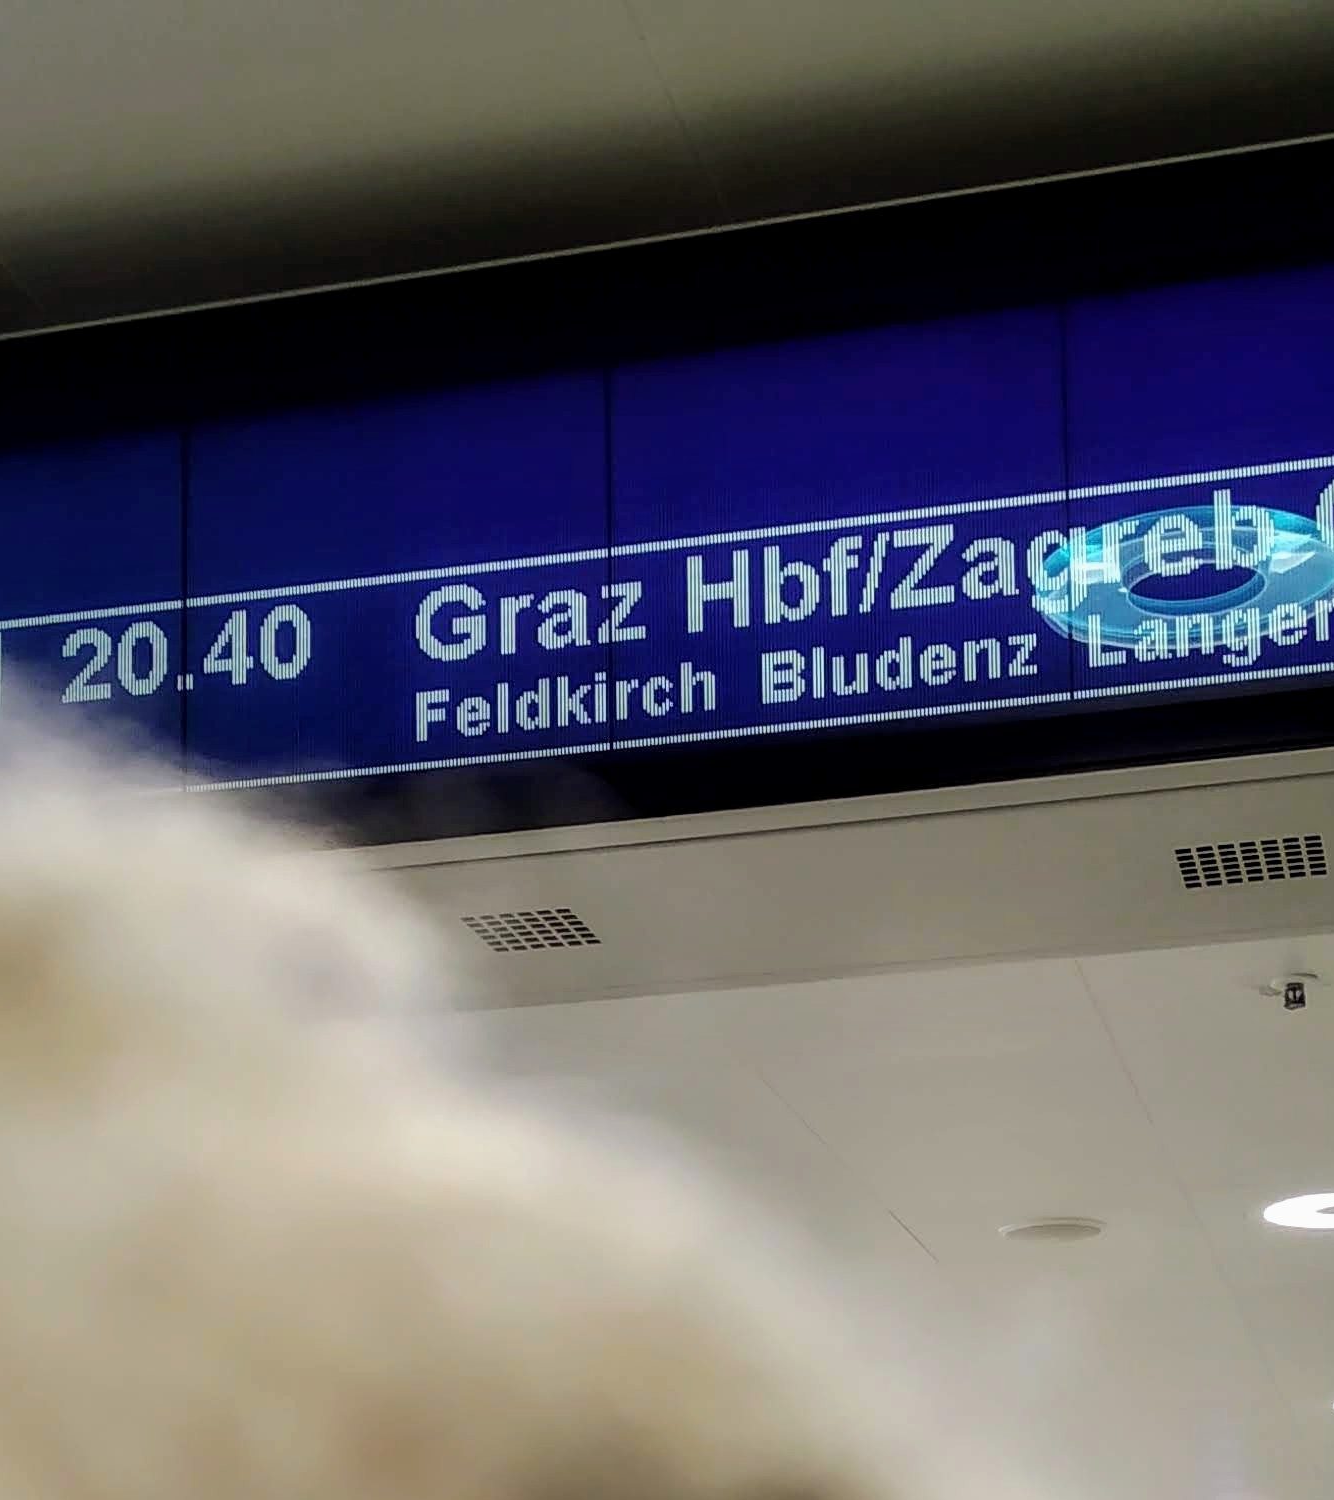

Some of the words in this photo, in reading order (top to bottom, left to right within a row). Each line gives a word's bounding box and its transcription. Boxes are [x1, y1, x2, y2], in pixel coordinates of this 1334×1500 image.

[62, 604, 312, 704] 20.40
[415, 582, 646, 661] Graz
[686, 489, 1275, 633] Hbf/Zagreb
[415, 662, 717, 742] Feldkirch
[761, 633, 1038, 704] Bludenz
